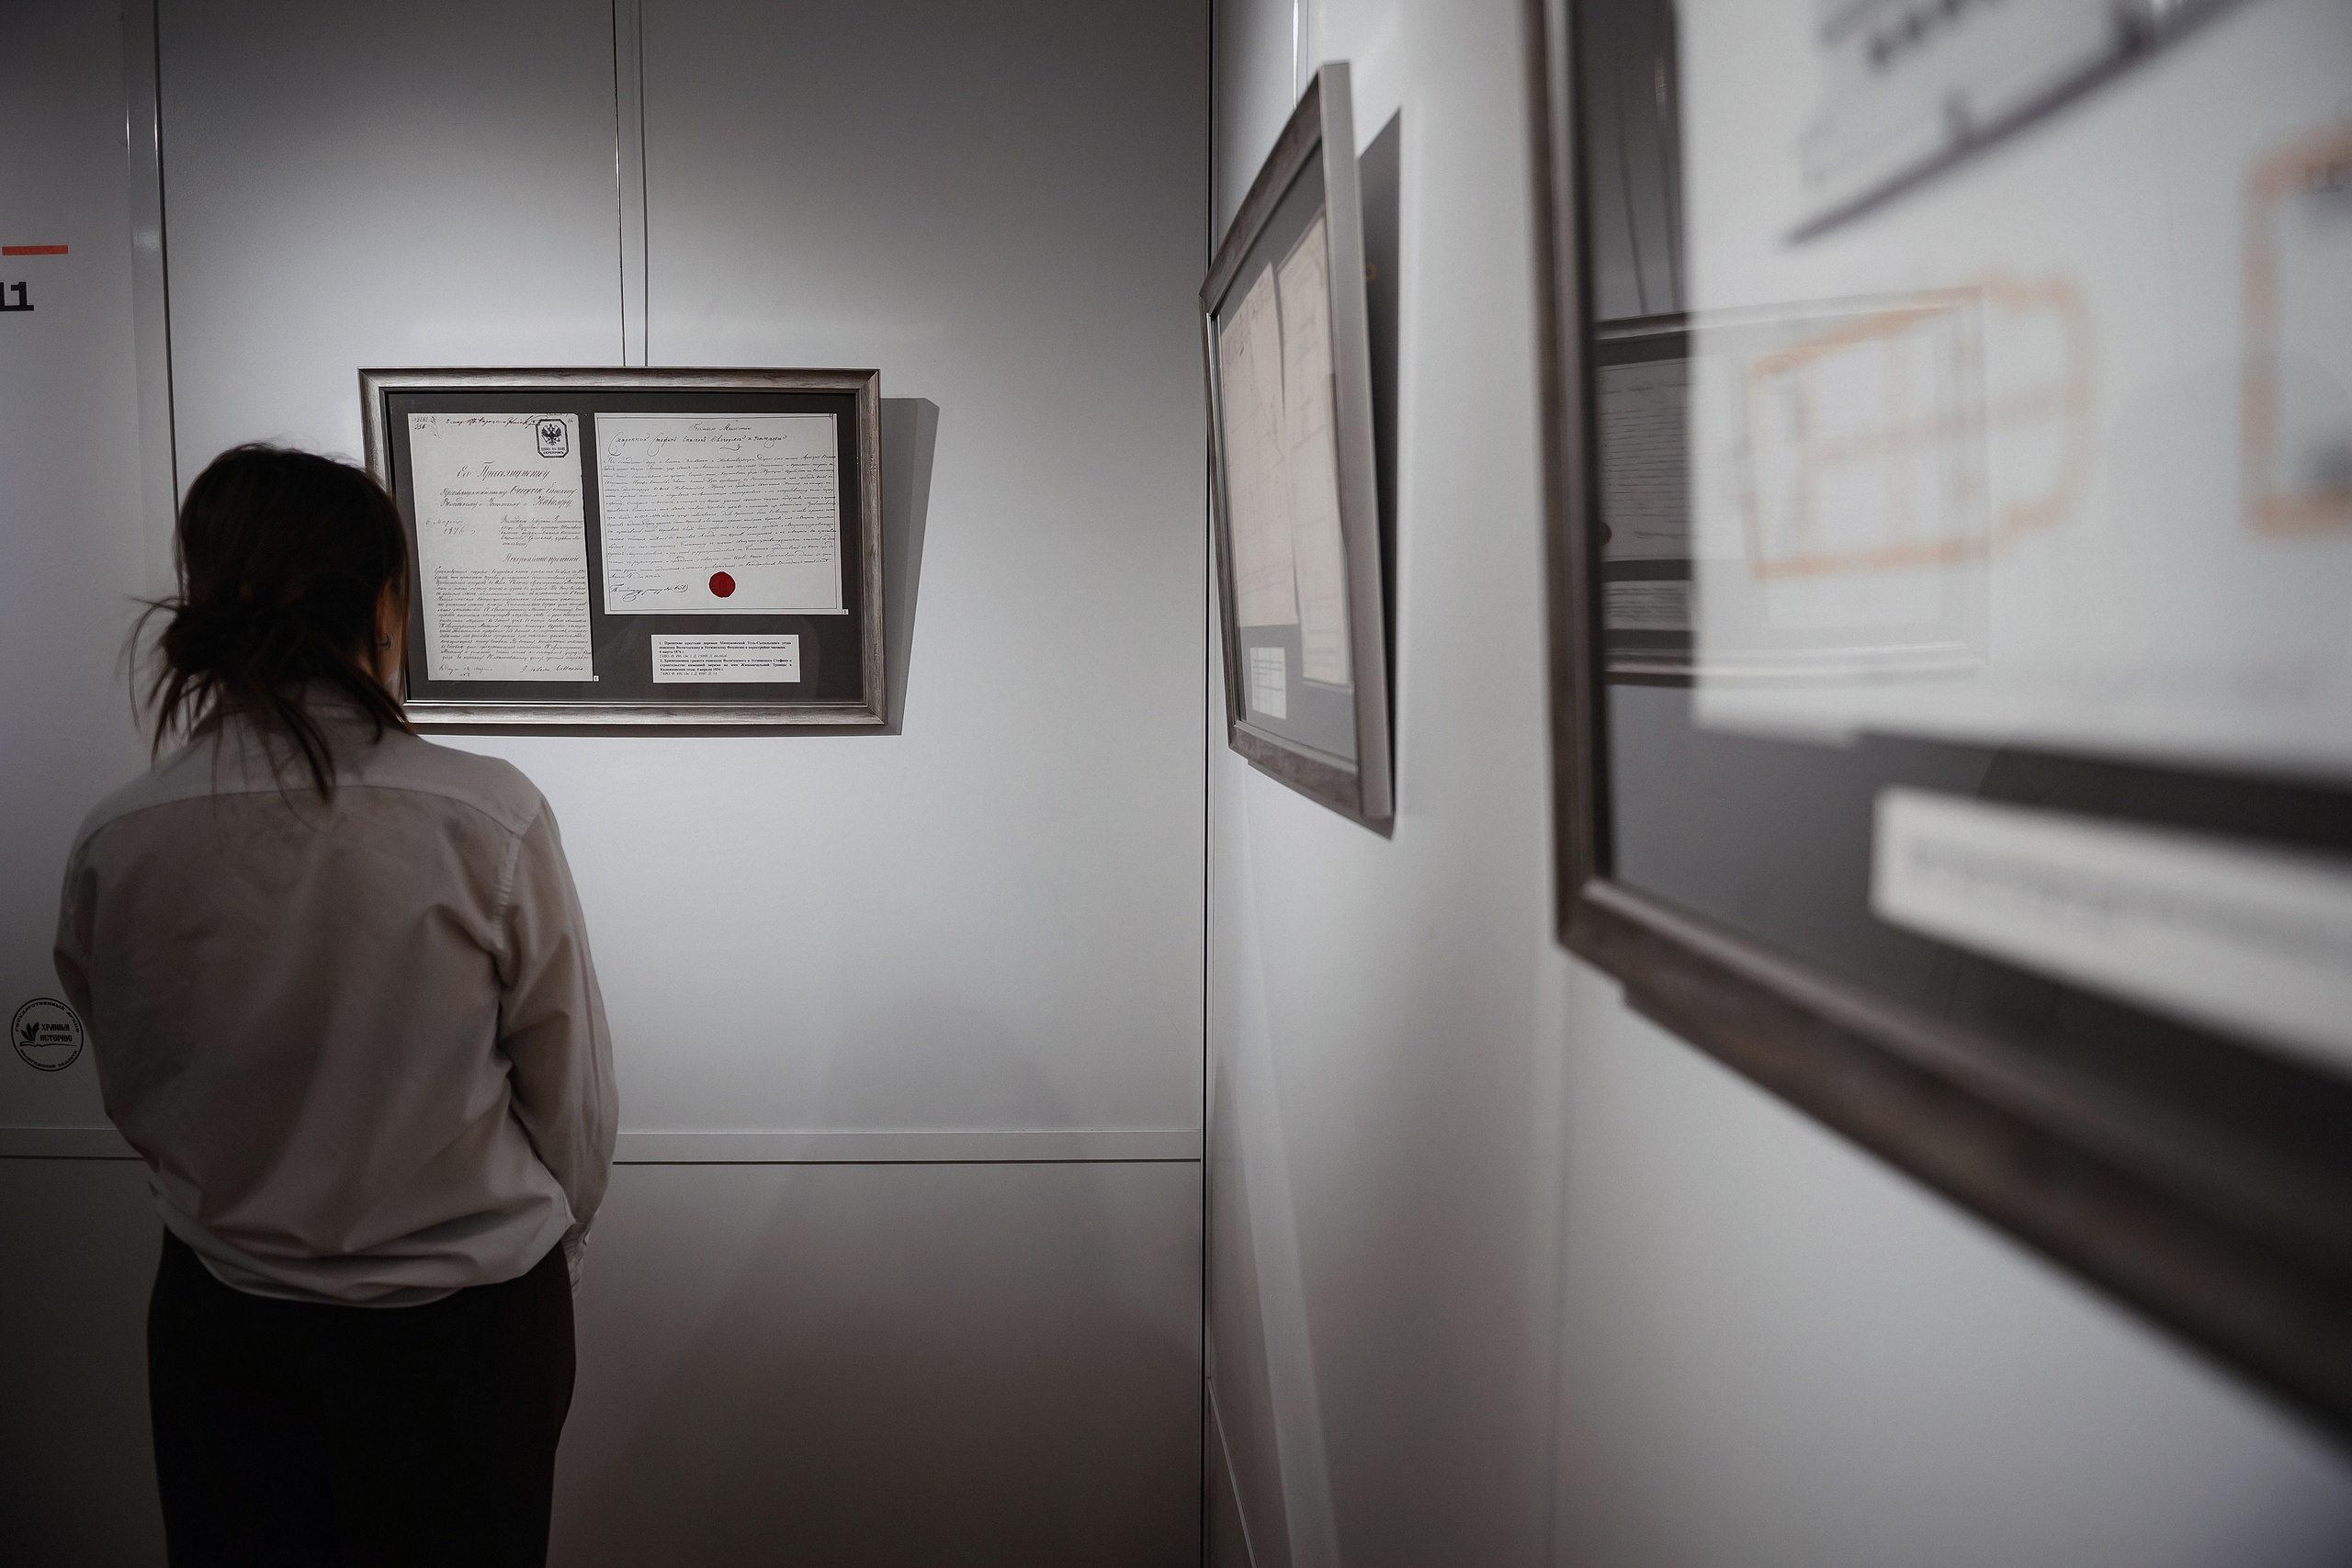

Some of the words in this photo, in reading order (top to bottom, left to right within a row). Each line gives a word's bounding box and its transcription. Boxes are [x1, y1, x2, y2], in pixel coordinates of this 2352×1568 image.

[65, 1011, 80, 1033] АРХИВ
[41, 1023, 70, 1032] ХРАНИМ
[40, 1034, 73, 1043] ИСТОРИЮ
